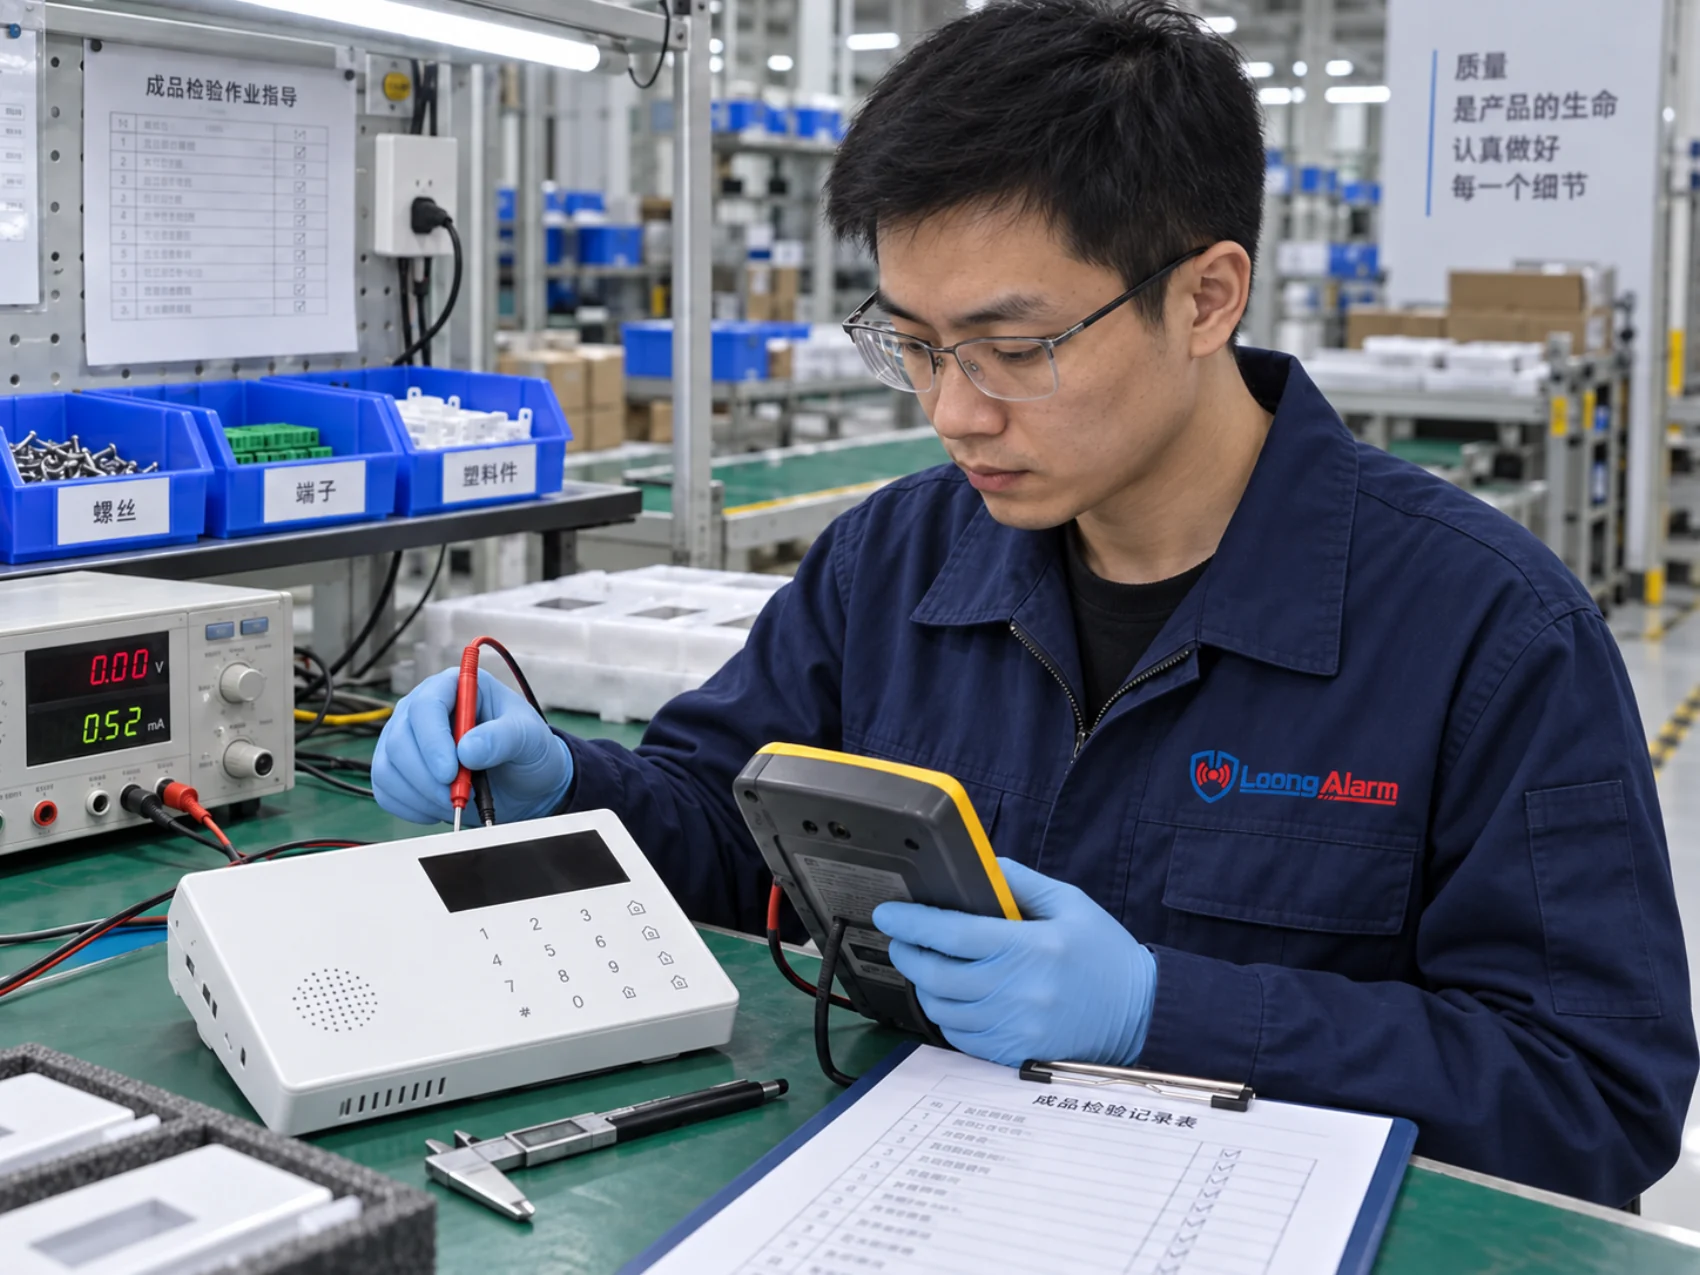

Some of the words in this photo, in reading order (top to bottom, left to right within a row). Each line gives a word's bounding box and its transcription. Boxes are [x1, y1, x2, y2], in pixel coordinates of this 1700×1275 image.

[1455, 52, 1508, 81] 质量
[146, 75, 297, 107] 成品检验作业指导
[1453, 90, 1618, 123] 是产品的生命
[1452, 135, 1560, 163] 认真做好
[1451, 172, 1588, 201] 每一个细节
[462, 462, 518, 487] 塑料件
[296, 480, 336, 504] 端子
[93, 498, 136, 524] 螺丝
[90, 648, 149, 685] 0.00
[155, 661, 164, 673] V
[82, 706, 142, 743] 0.52
[148, 718, 165, 731] mA
[479, 927, 489, 940] 1
[529, 917, 542, 931] 2
[580, 908, 592, 922] 3
[492, 953, 502, 966] 4
[544, 943, 556, 957] 5
[595, 935, 607, 948] 6
[504, 980, 515, 993] 7
[558, 969, 570, 983] 8
[608, 960, 620, 973] 9
[1032, 1094, 1198, 1130] 成品检验记录表
